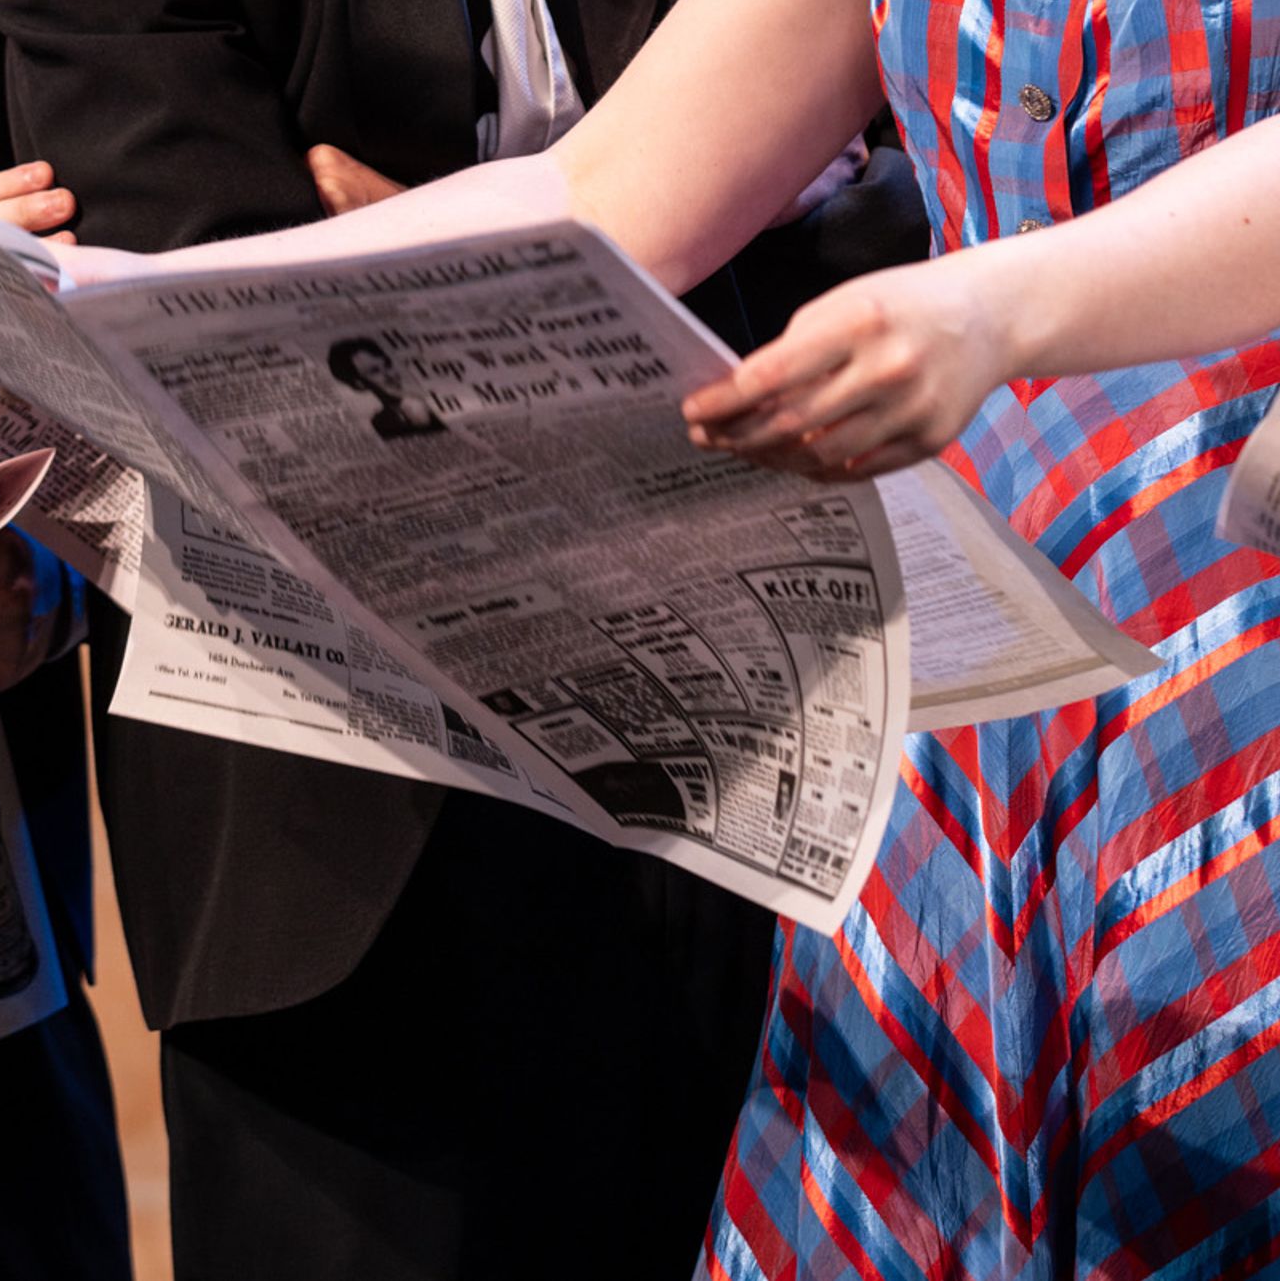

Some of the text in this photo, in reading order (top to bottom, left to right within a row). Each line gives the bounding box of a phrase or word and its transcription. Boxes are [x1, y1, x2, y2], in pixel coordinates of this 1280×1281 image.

[381, 305, 621, 353] Hynes and Powers
[405, 331, 652, 384] Top Ward Voting
[427, 357, 672, 413] In Mayor's Fight
[763, 577, 872, 606] KICK-OFF!
[163, 612, 230, 640] GERALD
[233, 629, 245, 645] J.
[251, 631, 322, 662] VALLATI
[326, 649, 348, 668] CO.
